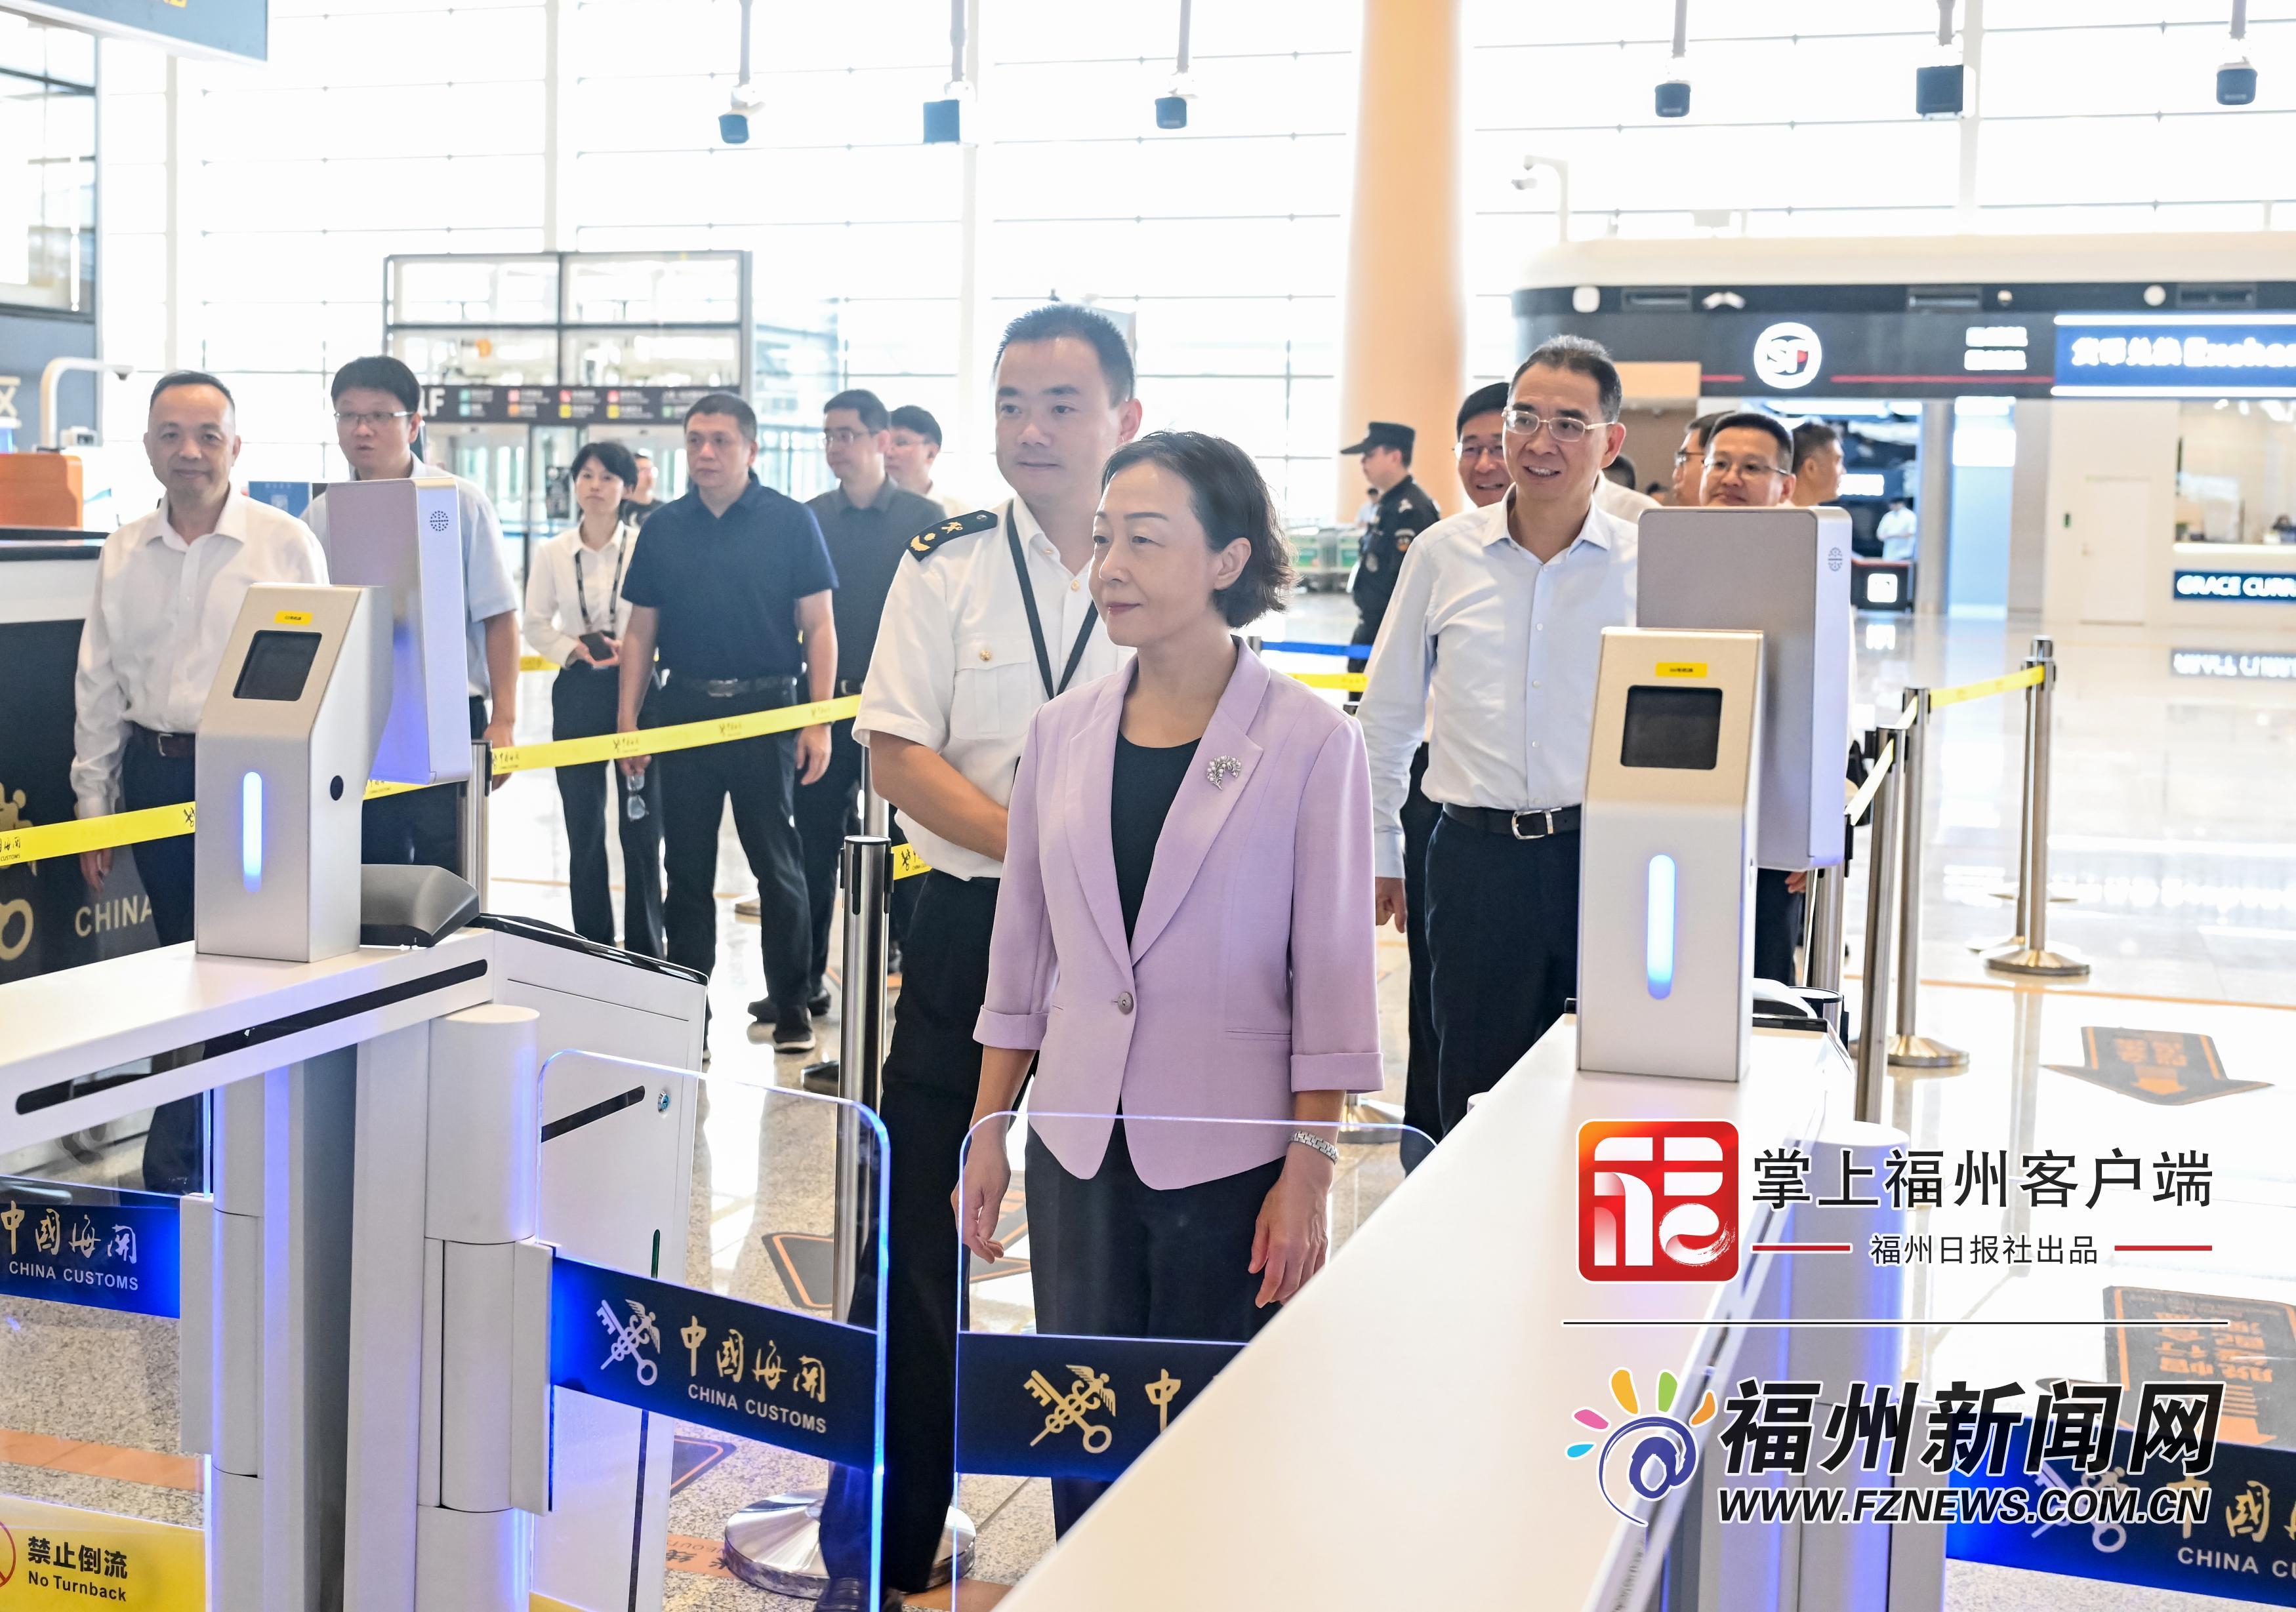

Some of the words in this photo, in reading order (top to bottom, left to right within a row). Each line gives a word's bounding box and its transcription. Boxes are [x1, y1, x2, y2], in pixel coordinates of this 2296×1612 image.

[9, 1261, 56, 1280] CHINA
[64, 1268, 138, 1291] CUSTOMS
[689, 1384, 739, 1411] CHINA
[745, 1399, 827, 1434] CUSTOMS
[28, 1536, 128, 1579] 禁止倒流
[2177, 1546, 2259, 1575] CHINA
[28, 1570, 49, 1586] No
[53, 1575, 127, 1602] Turnback
